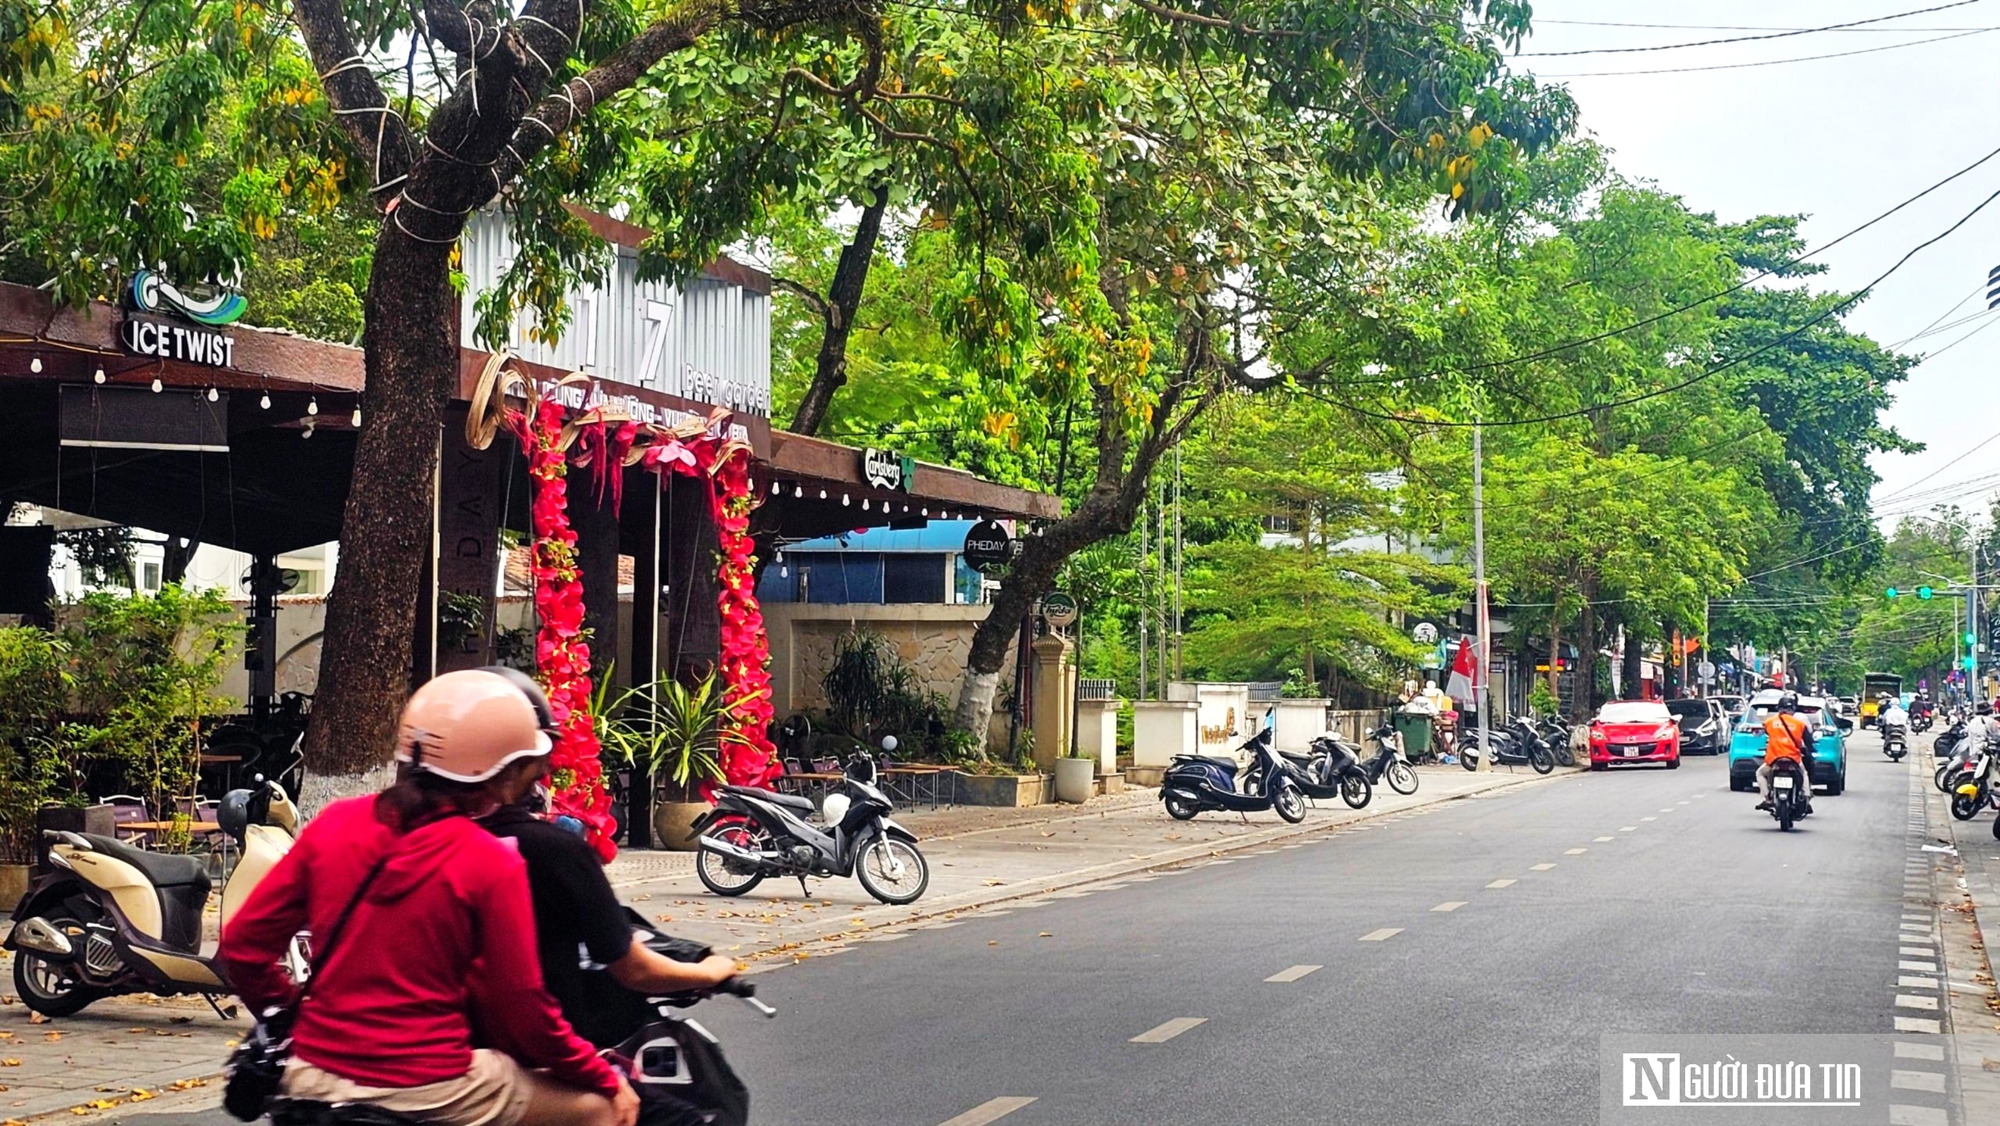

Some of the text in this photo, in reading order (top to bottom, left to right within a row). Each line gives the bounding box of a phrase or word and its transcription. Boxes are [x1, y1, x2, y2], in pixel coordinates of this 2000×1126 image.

[133, 321, 234, 367] ICE TWIST
[683, 363, 771, 410] Beer garden
[865, 448, 900, 489] Carlsberg
[967, 540, 1005, 551] PHEDAY
